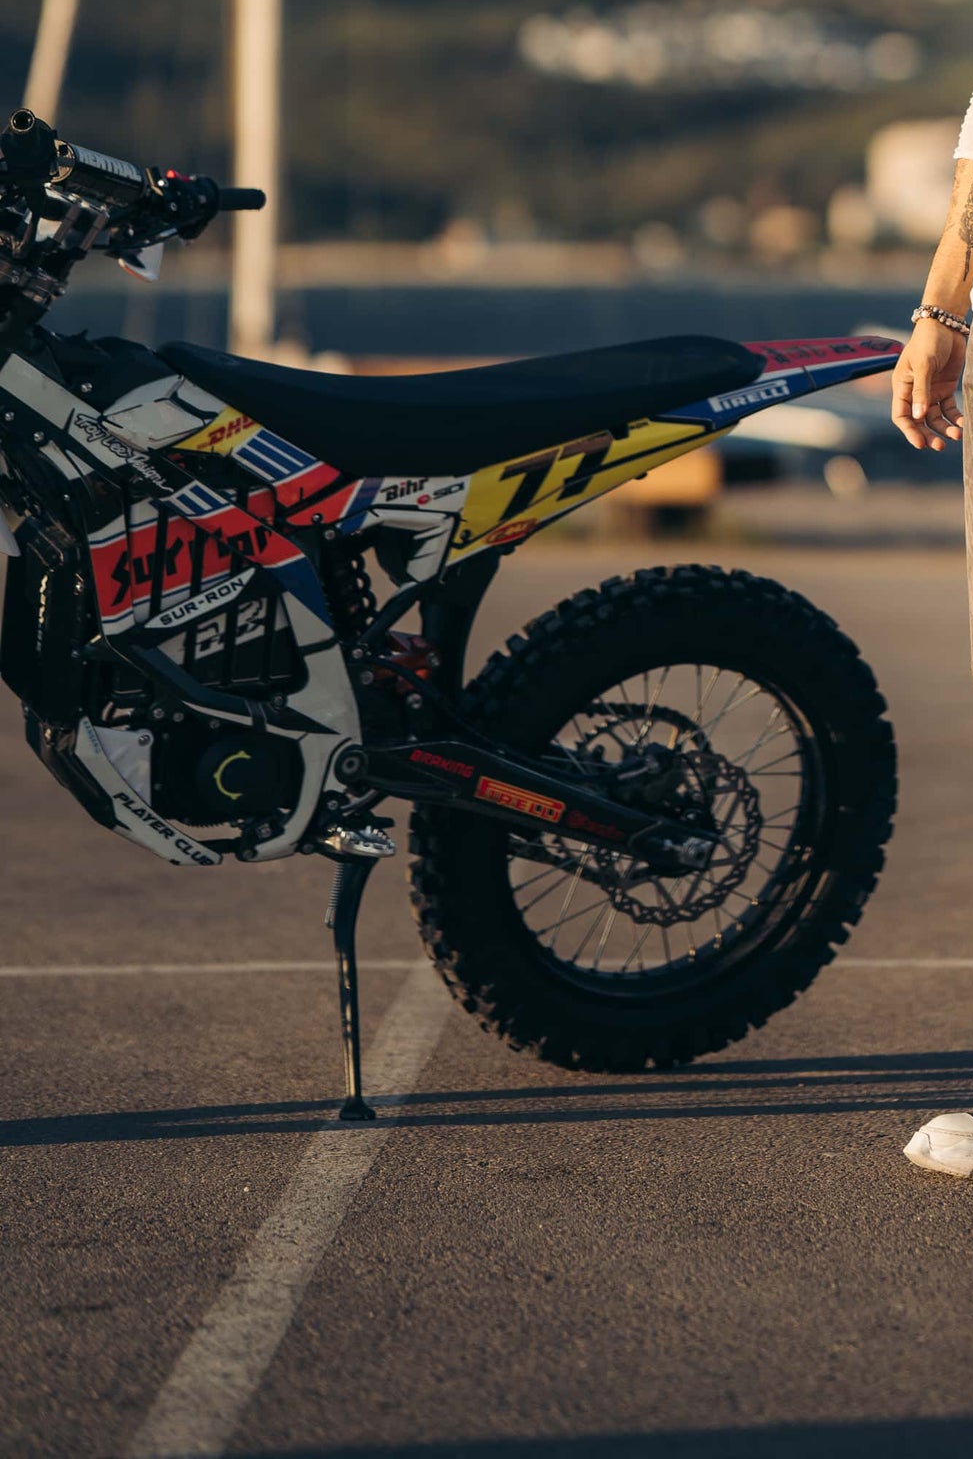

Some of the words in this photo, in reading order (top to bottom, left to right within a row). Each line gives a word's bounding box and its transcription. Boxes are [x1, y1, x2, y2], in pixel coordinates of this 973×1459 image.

[707, 379, 791, 413] PIRELLI
[74, 413, 107, 443] Troy
[208, 415, 255, 445] DHL
[380, 476, 429, 502] Bihr
[161, 578, 247, 625] SUR-RON
[409, 748, 475, 779] BRAKING
[477, 778, 565, 823] PIRELLI
[113, 792, 176, 839] PLAYER
[175, 838, 215, 866] CLUB
